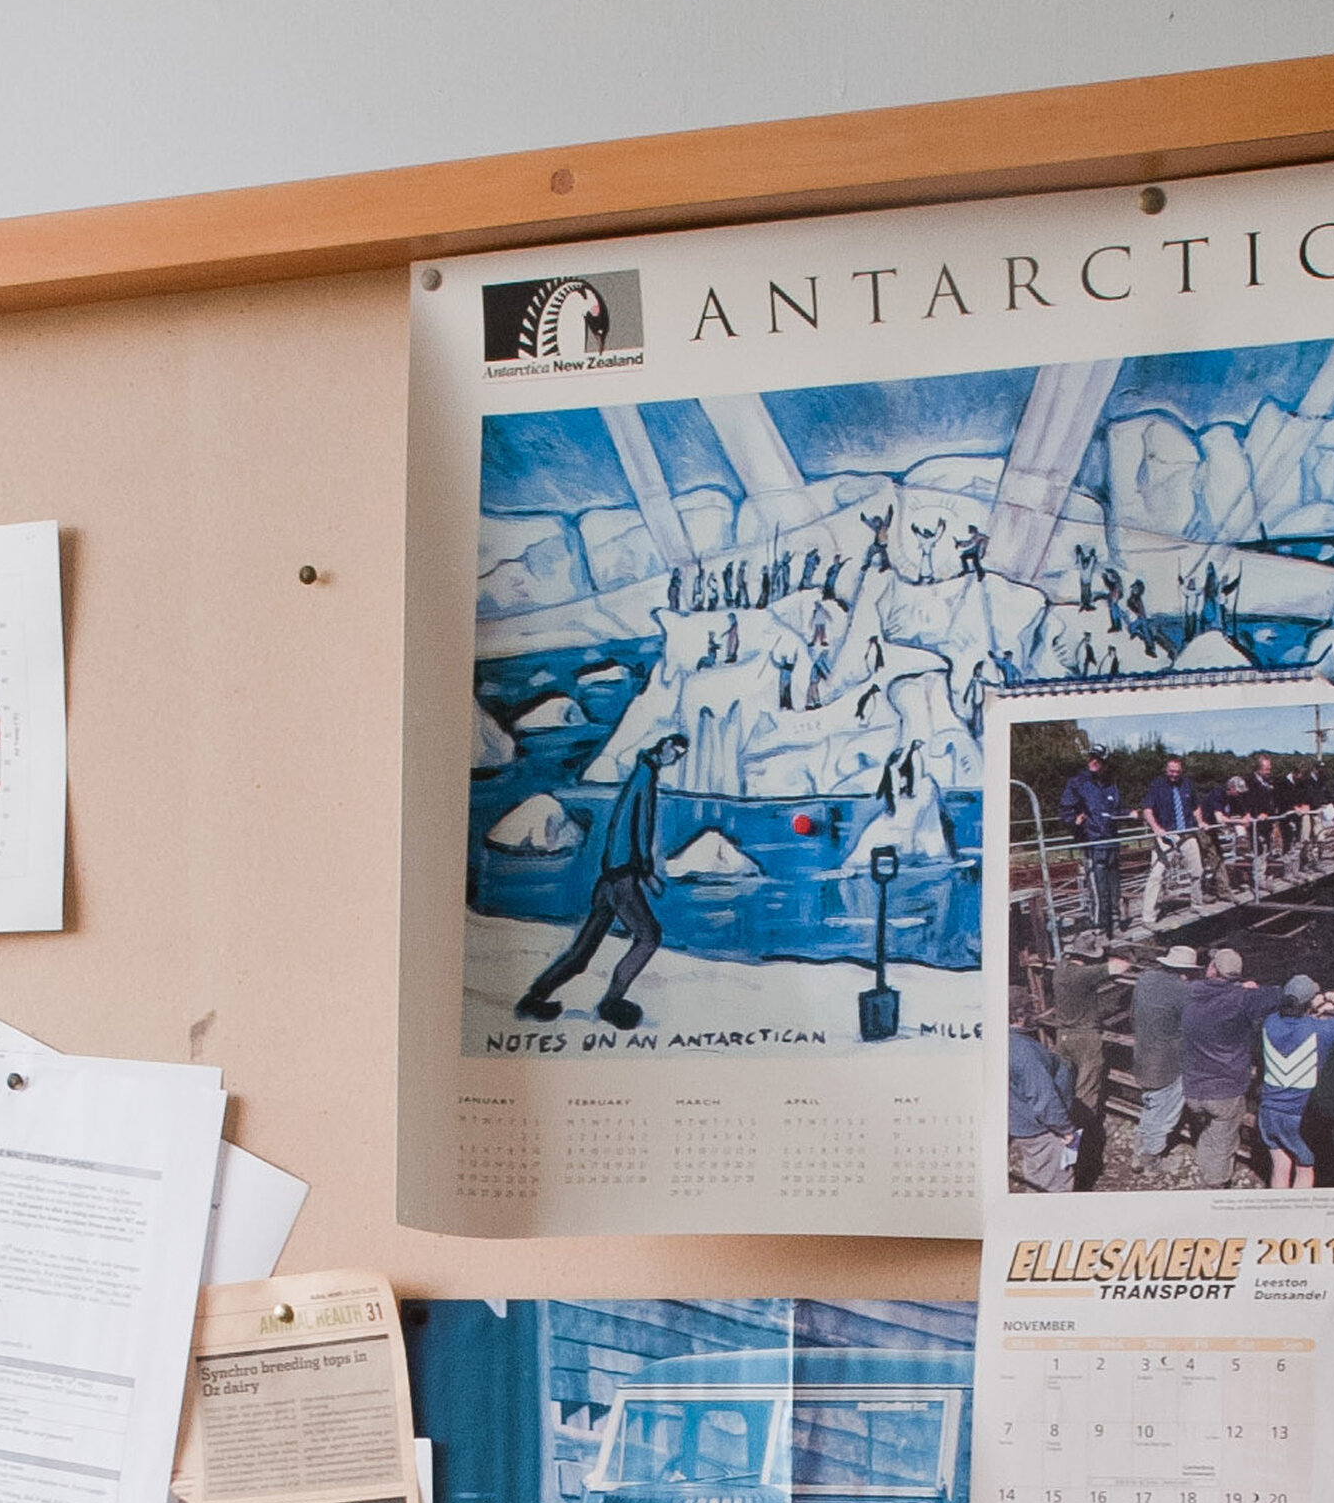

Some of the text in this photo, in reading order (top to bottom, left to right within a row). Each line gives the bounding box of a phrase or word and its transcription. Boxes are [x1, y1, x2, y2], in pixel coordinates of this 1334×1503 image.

[483, 352, 644, 380] Antarctica New Zealand
[486, 1032, 568, 1053] NOTES
[583, 1030, 616, 1051] ON
[627, 1030, 658, 1050] AN
[668, 1027, 825, 1048] ANTARCTICAN
[675, 1098, 721, 1106] MARCH
[894, 1096, 920, 1104] MAY
[1006, 1238, 1246, 1282] ELLESMERE
[1100, 1283, 1235, 1300] TRANSPORT
[1255, 1277, 1308, 1288] Leeston
[1254, 1290, 1326, 1301] Dunsandel
[316, 1304, 363, 1327] HEALTH
[365, 1302, 383, 1322] 31
[1003, 1321, 1076, 1332] NOVEMBER
[201, 1350, 368, 1383] Synchro breeding tops in
[1053, 1357, 1286, 1373] 1 2 3 4 5 6
[202, 1380, 260, 1399] Oz dairy
